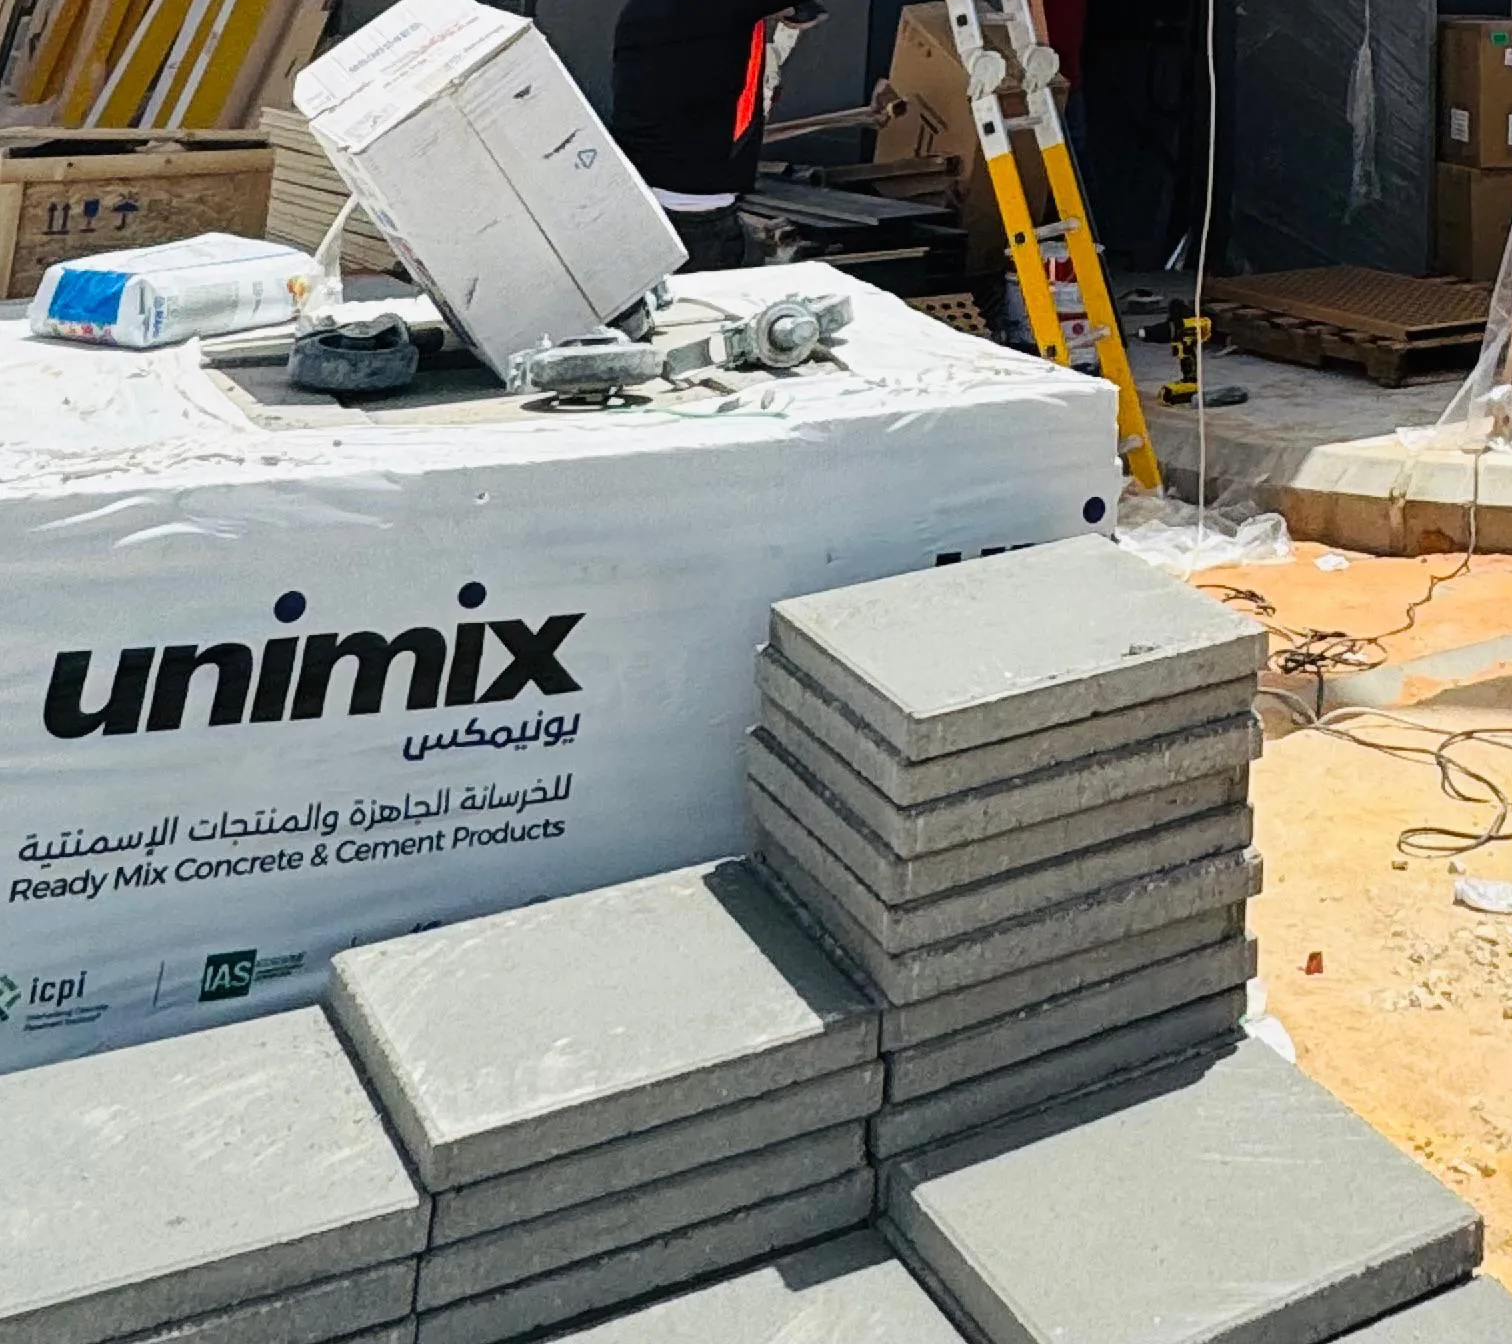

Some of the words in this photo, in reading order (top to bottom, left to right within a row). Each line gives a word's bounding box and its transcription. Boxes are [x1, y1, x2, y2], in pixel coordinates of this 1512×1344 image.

[43, 581, 587, 739] unimix
[402, 710, 581, 761] يونيمكس
[350, 787, 450, 831] الجاهزة
[460, 773, 572, 814] للخرسانة
[18, 815, 179, 870] الإسمنتية
[188, 801, 339, 846] والمنتجات
[9, 869, 109, 903] Ready
[113, 862, 168, 890] Mix
[174, 848, 304, 882] Concrete
[310, 843, 328, 867] &
[335, 829, 446, 863] Cement
[452, 817, 565, 849] Products
[29, 970, 88, 1007] icpi
[203, 960, 253, 993] IAS
